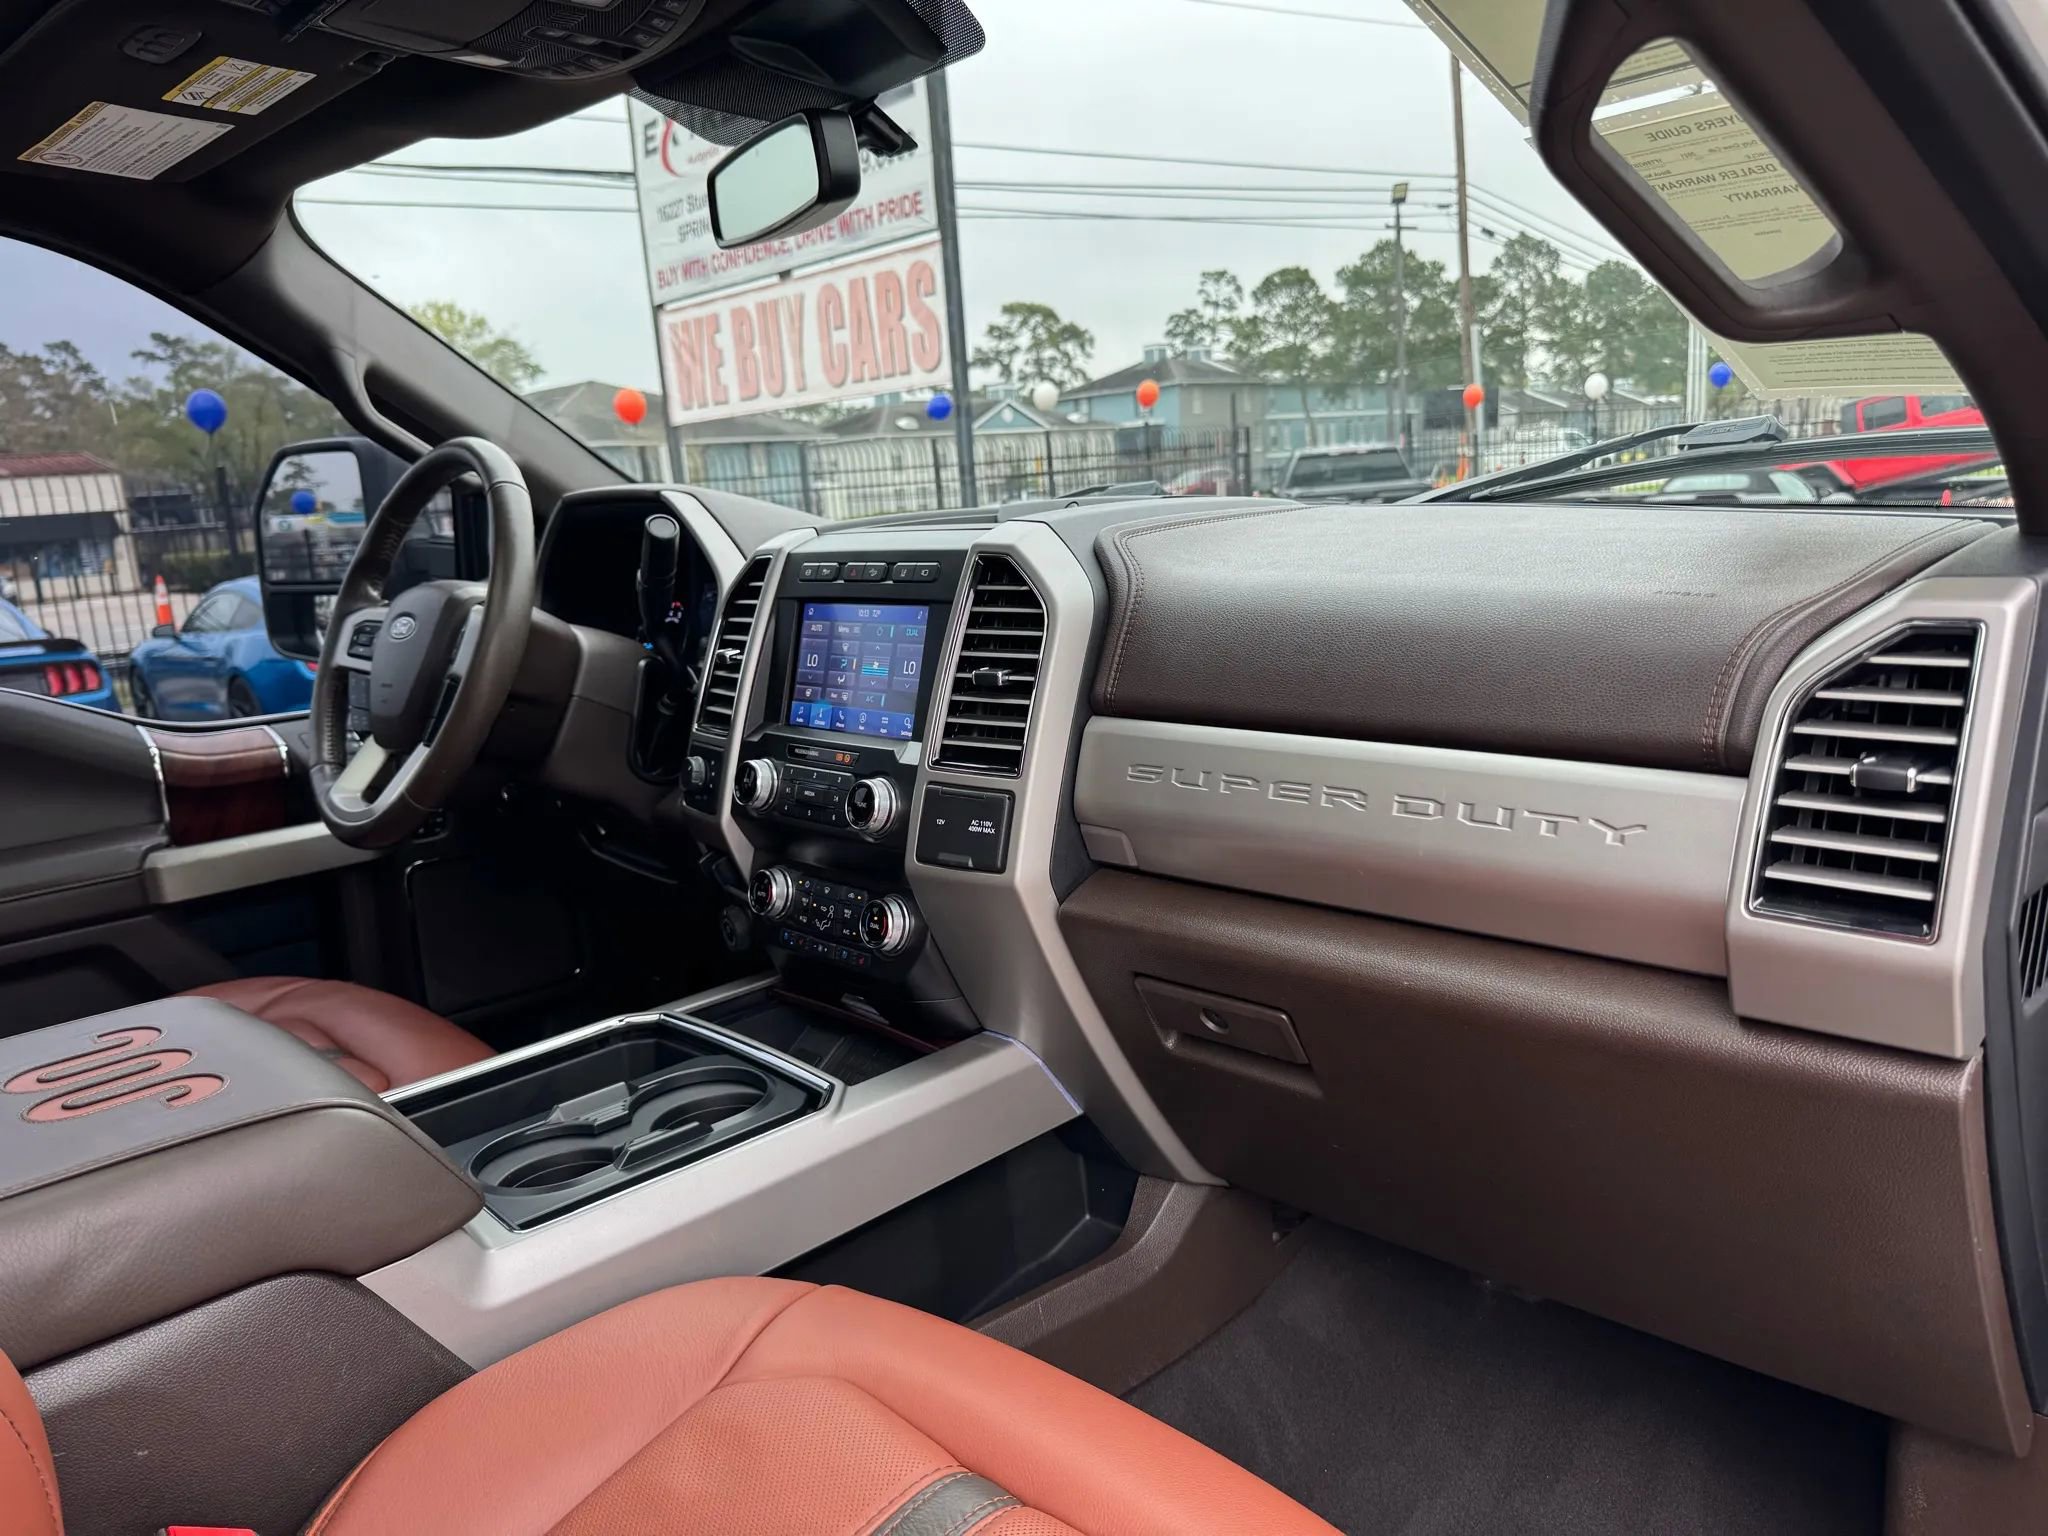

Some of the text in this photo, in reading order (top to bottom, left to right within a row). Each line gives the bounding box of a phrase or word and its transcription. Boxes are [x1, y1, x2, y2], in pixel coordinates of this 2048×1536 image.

[677, 218, 711, 243] SPRIN
[657, 264, 679, 290] BUY
[681, 256, 709, 281] WITH
[837, 205, 875, 237] WITH
[877, 191, 924, 225] PRIDE
[668, 259, 942, 411] WE BUY CARS
[811, 624, 823, 632] AUTO
[906, 628, 919, 637] DUAL
[807, 654, 819, 668] LO
[903, 661, 916, 675] LO
[1127, 763, 1648, 847] SUPER DUTY
[971, 819, 980, 827] AC
